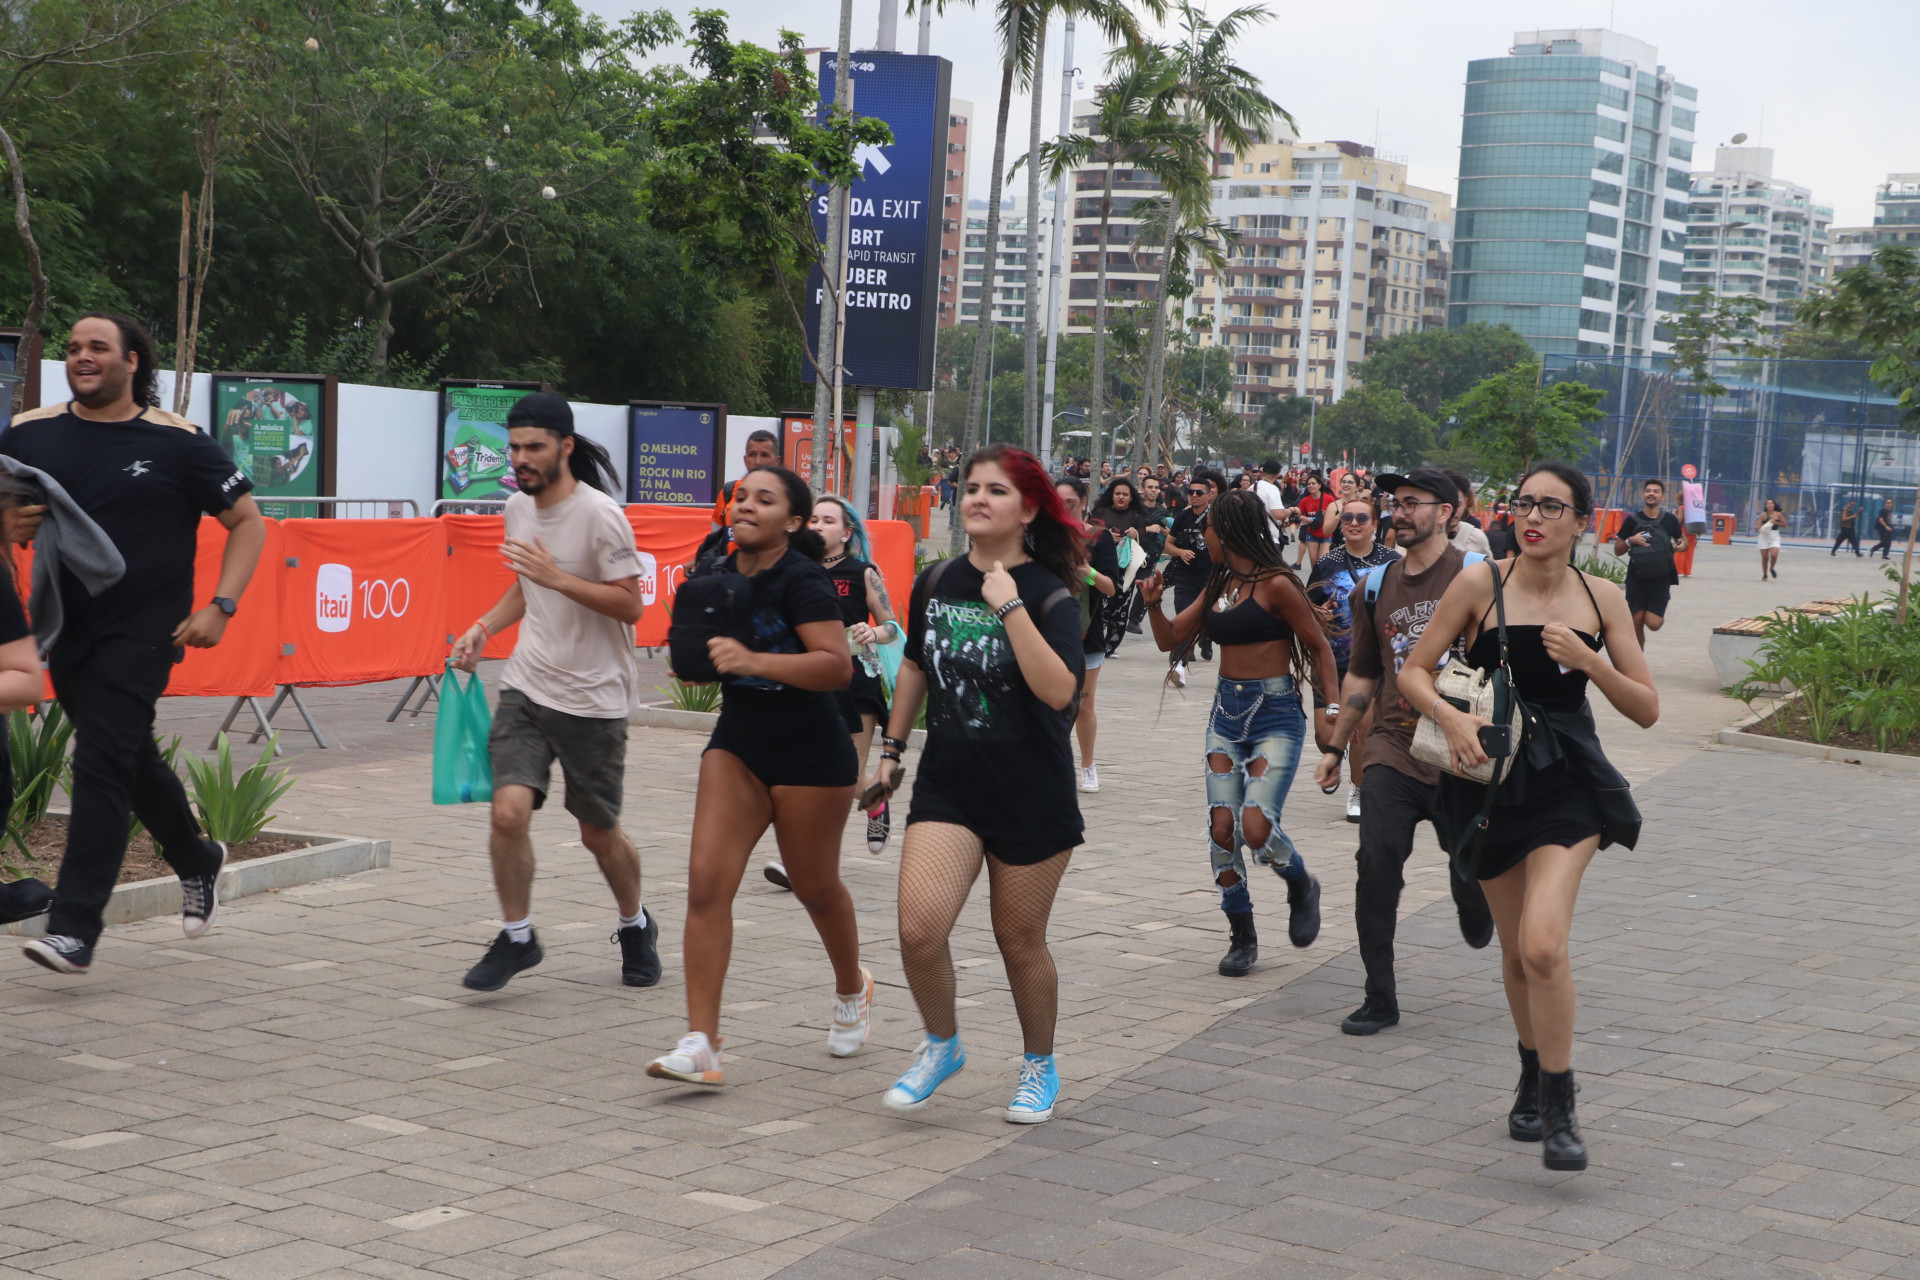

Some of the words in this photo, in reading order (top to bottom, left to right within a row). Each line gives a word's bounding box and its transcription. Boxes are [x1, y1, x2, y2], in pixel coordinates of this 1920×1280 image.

[817, 196, 875, 217] SDA
[882, 199, 921, 219] EXIT
[851, 228, 884, 246] BRT
[848, 249, 870, 262] APID
[874, 250, 916, 264] TRANSIT
[816, 288, 911, 310] RCENTRO
[475, 451, 503, 463] Trident
[640, 443, 650, 453] O
[651, 443, 697, 455] MELHOR
[640, 455, 657, 465] DO
[640, 466, 670, 478] ROCK
[671, 468, 684, 478] IN
[686, 469, 707, 480] RIO
[221, 470, 245, 493] NEW
[639, 477, 653, 489] TÁ
[654, 479, 671, 490] NA
[638, 490, 653, 501] TV
[654, 491, 696, 503] GLOBO.
[639, 575, 654, 595] aú
[662, 564, 685, 597] 10
[319, 591, 348, 619] itaú
[359, 577, 410, 620] 100
[1389, 599, 1442, 625] PLEN
